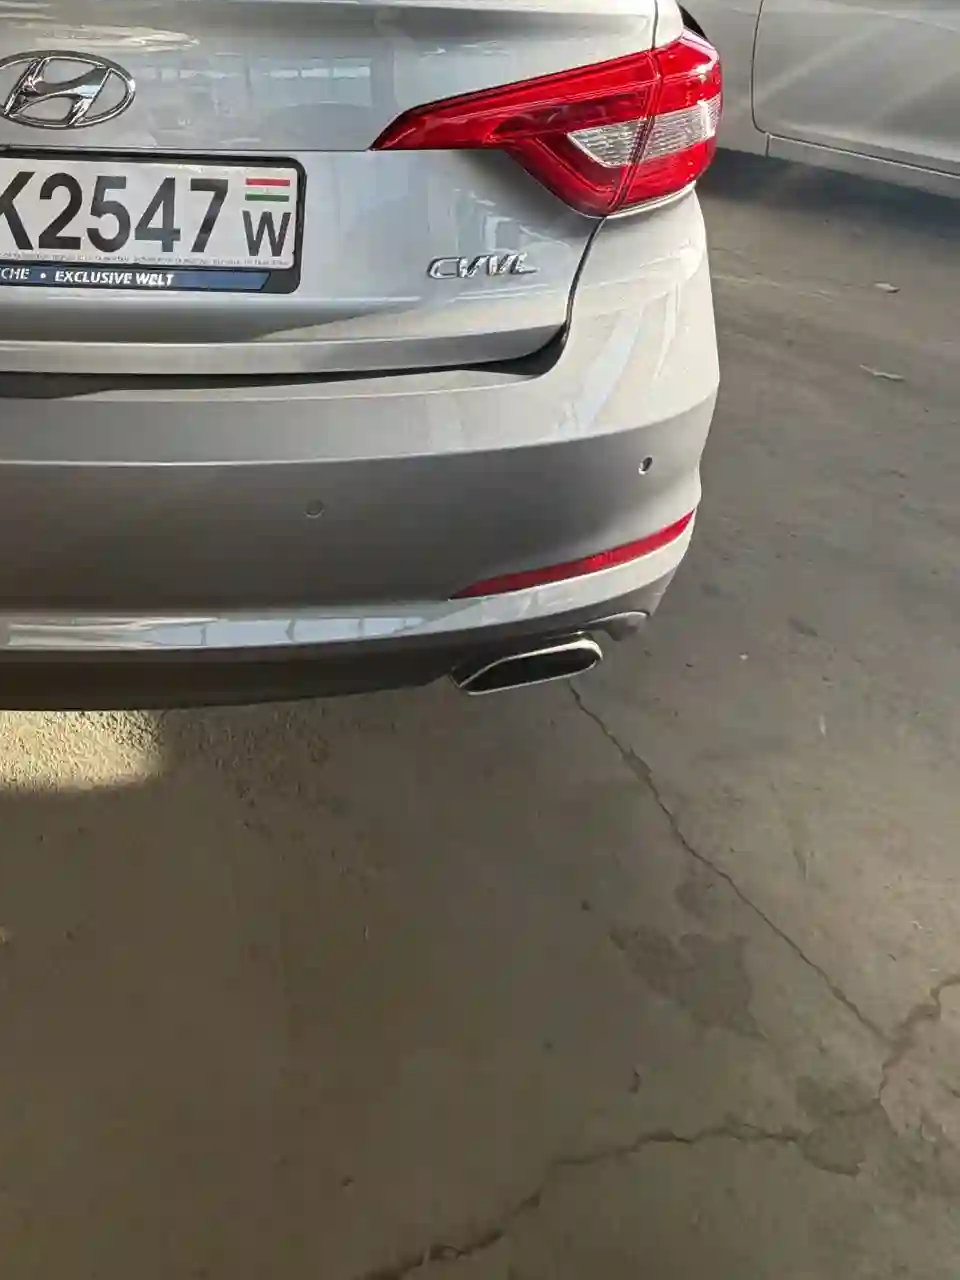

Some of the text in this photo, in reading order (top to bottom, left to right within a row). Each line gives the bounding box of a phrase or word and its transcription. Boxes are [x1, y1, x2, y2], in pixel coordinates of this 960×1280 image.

[243, 210, 291, 257] W
[54, 270, 132, 285] EXCLUSIVE
[136, 272, 175, 287] WELT
